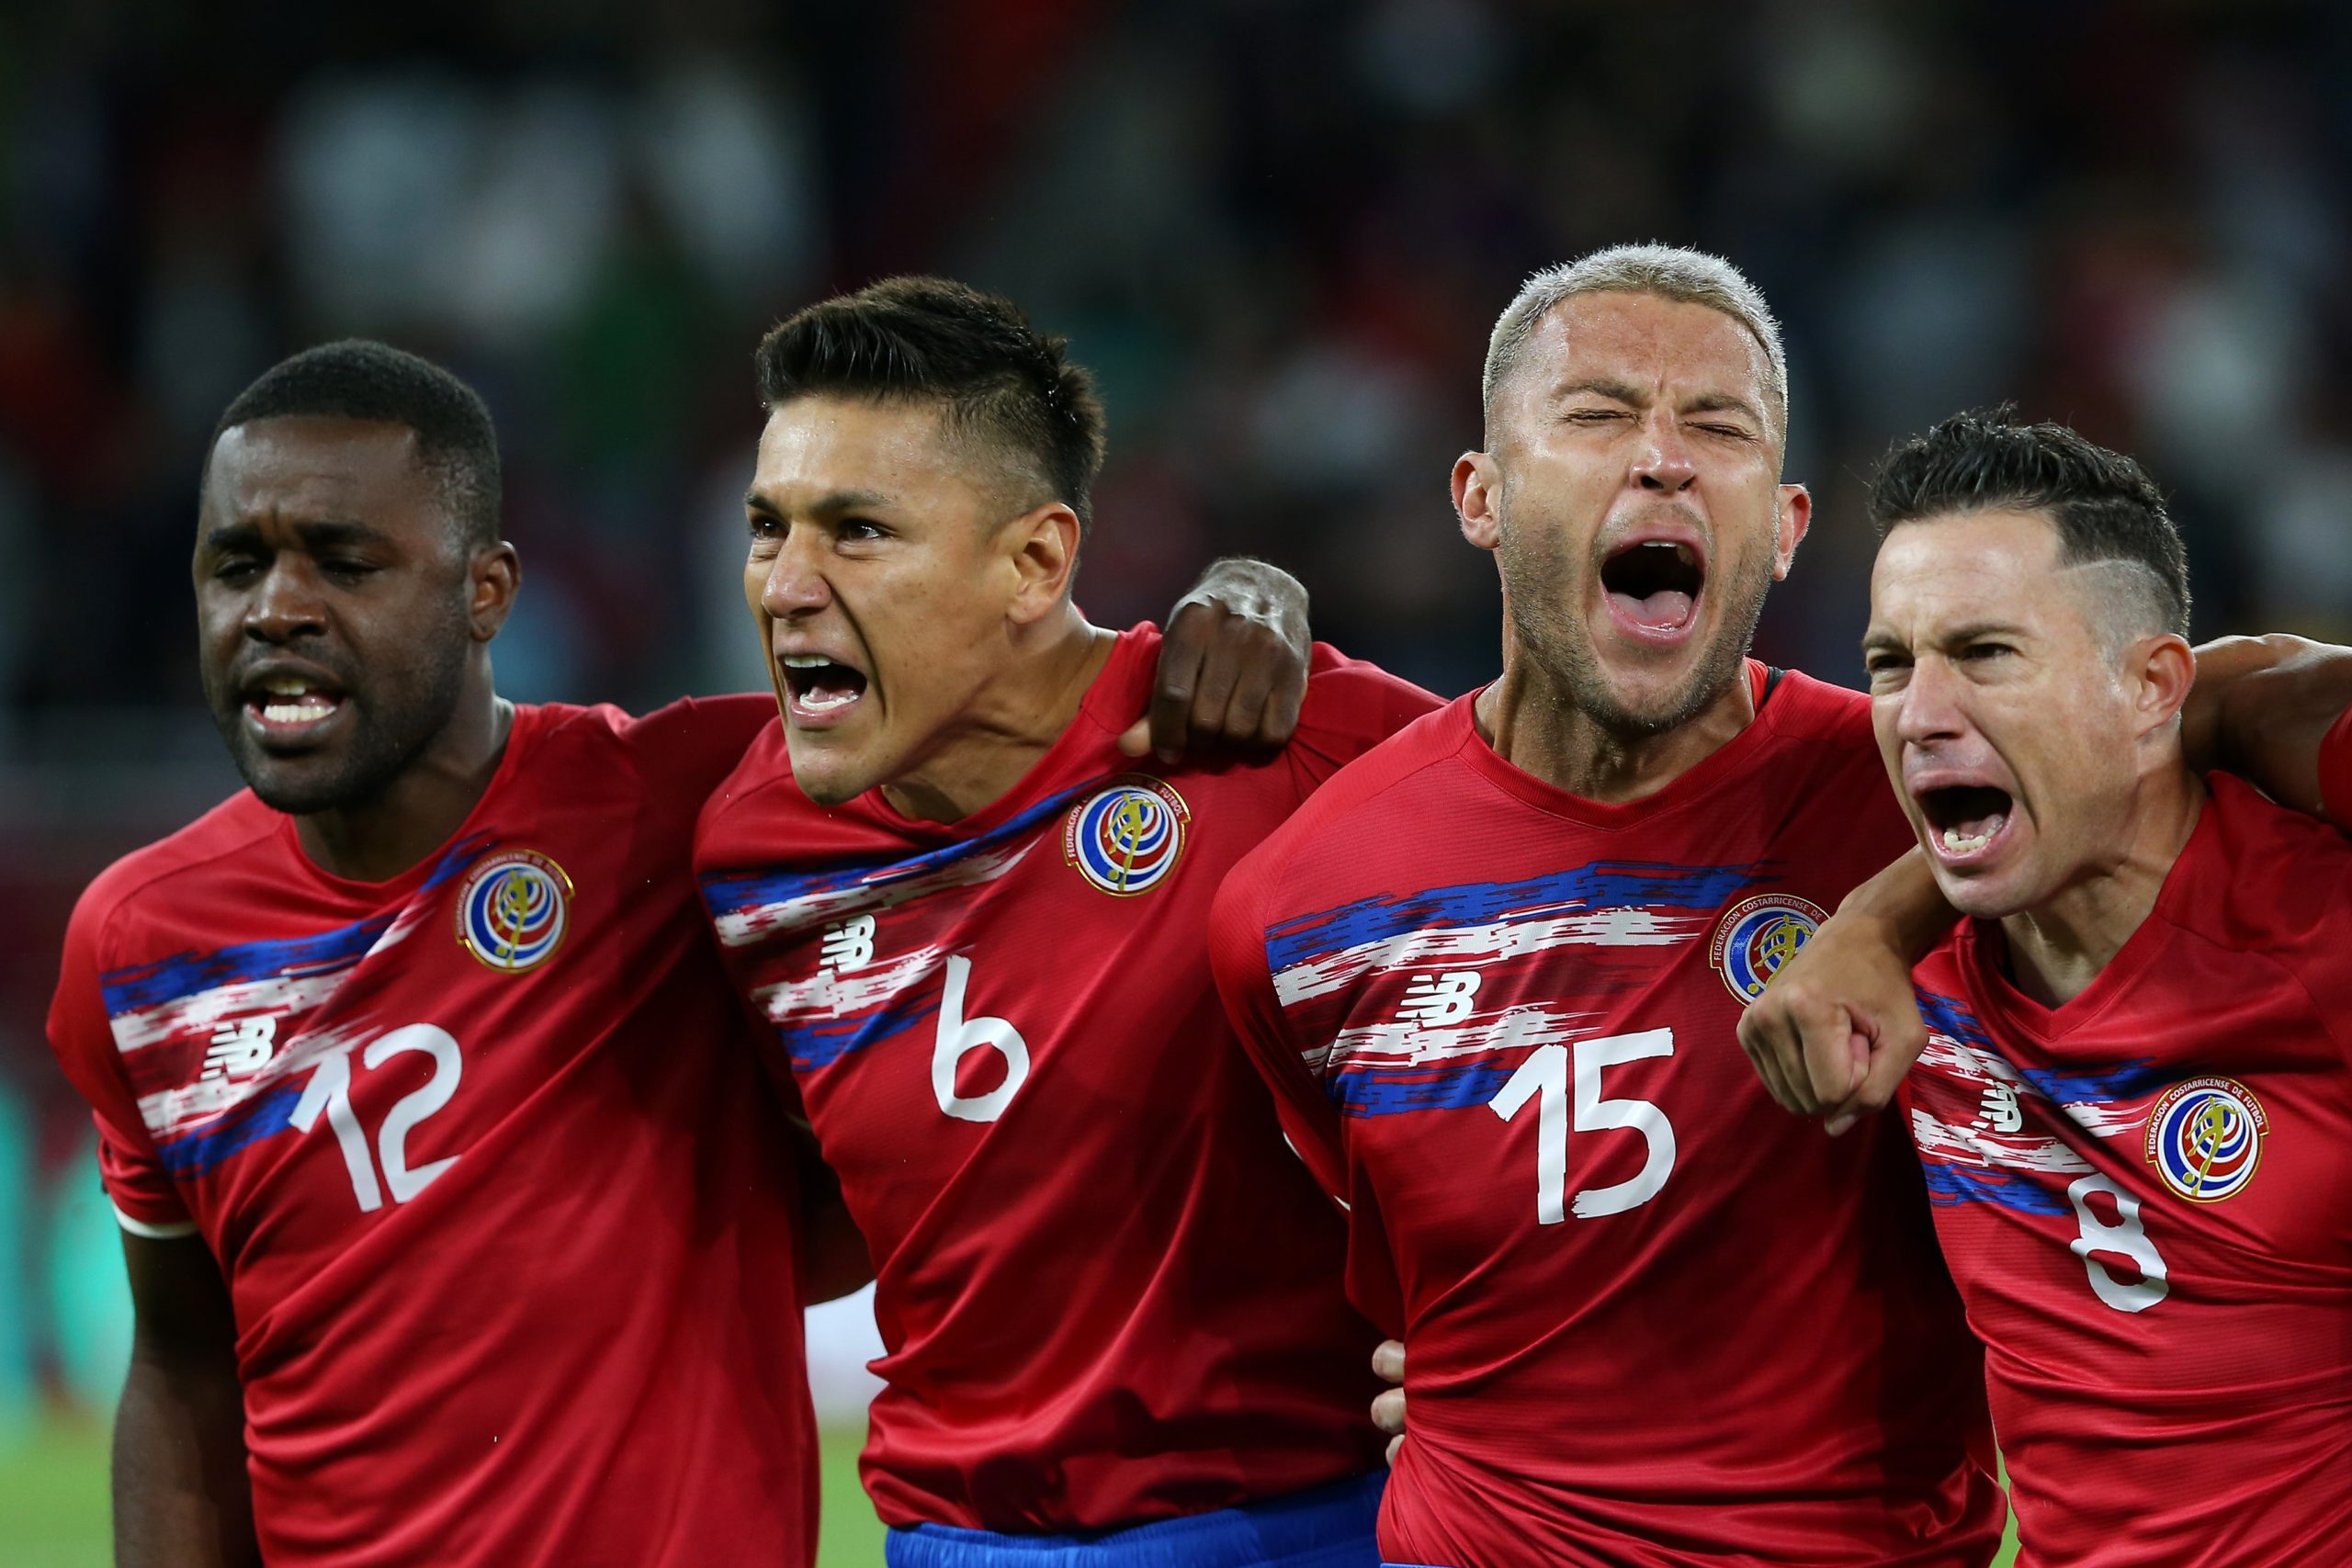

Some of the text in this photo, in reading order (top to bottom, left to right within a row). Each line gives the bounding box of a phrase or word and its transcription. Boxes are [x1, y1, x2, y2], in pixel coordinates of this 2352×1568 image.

[1159, 788, 1183, 817] FUTBOL
[1713, 897, 1822, 961] FEDERACION COSTARRICENSE DE
[932, 954, 1031, 1122] 6
[1390, 970, 1482, 1029] NB
[288, 1023, 462, 1213] 12
[1487, 1026, 1676, 1224] 15
[2148, 1078, 2264, 1155] FEDERACION COSTARRICENSE DE FUTBOL
[2068, 1173, 2169, 1313] 8
